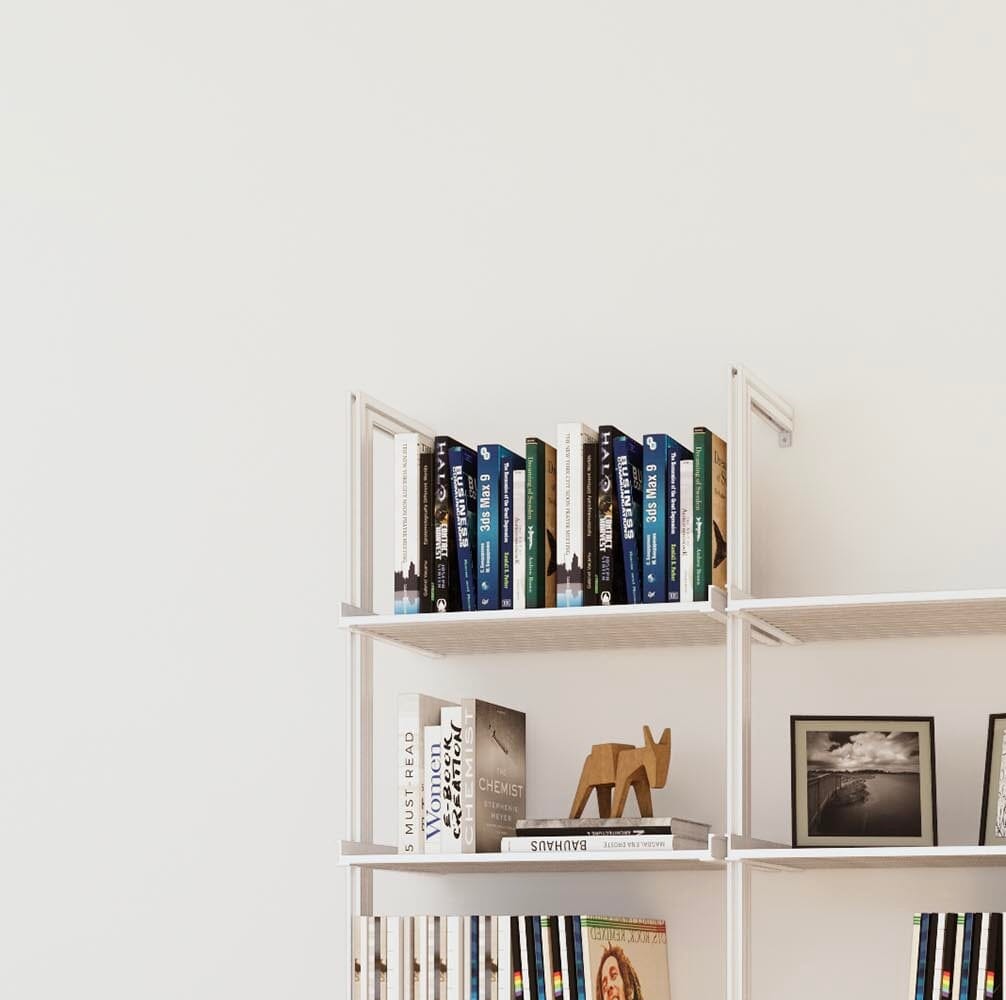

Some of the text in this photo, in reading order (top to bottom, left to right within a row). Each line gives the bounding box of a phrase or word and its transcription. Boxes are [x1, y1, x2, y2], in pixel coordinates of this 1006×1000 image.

[437, 441, 447, 502] HALO
[600, 432, 611, 492] HALO
[456, 465, 469, 548] BUSINESS
[480, 484, 490, 508] Max
[480, 511, 490, 532] 3ds
[621, 455, 634, 539] BUSINESS
[646, 464, 657, 523] 3ds Max 9
[426, 742, 441, 841] Women
[443, 732, 453, 828] E-BOOK
[451, 720, 462, 840] CREATION
[464, 707, 474, 846] CHEMIST
[478, 777, 524, 799] CHEMIST
[490, 813, 512, 822] MEYER
[530, 840, 587, 852] BAUHAUS
